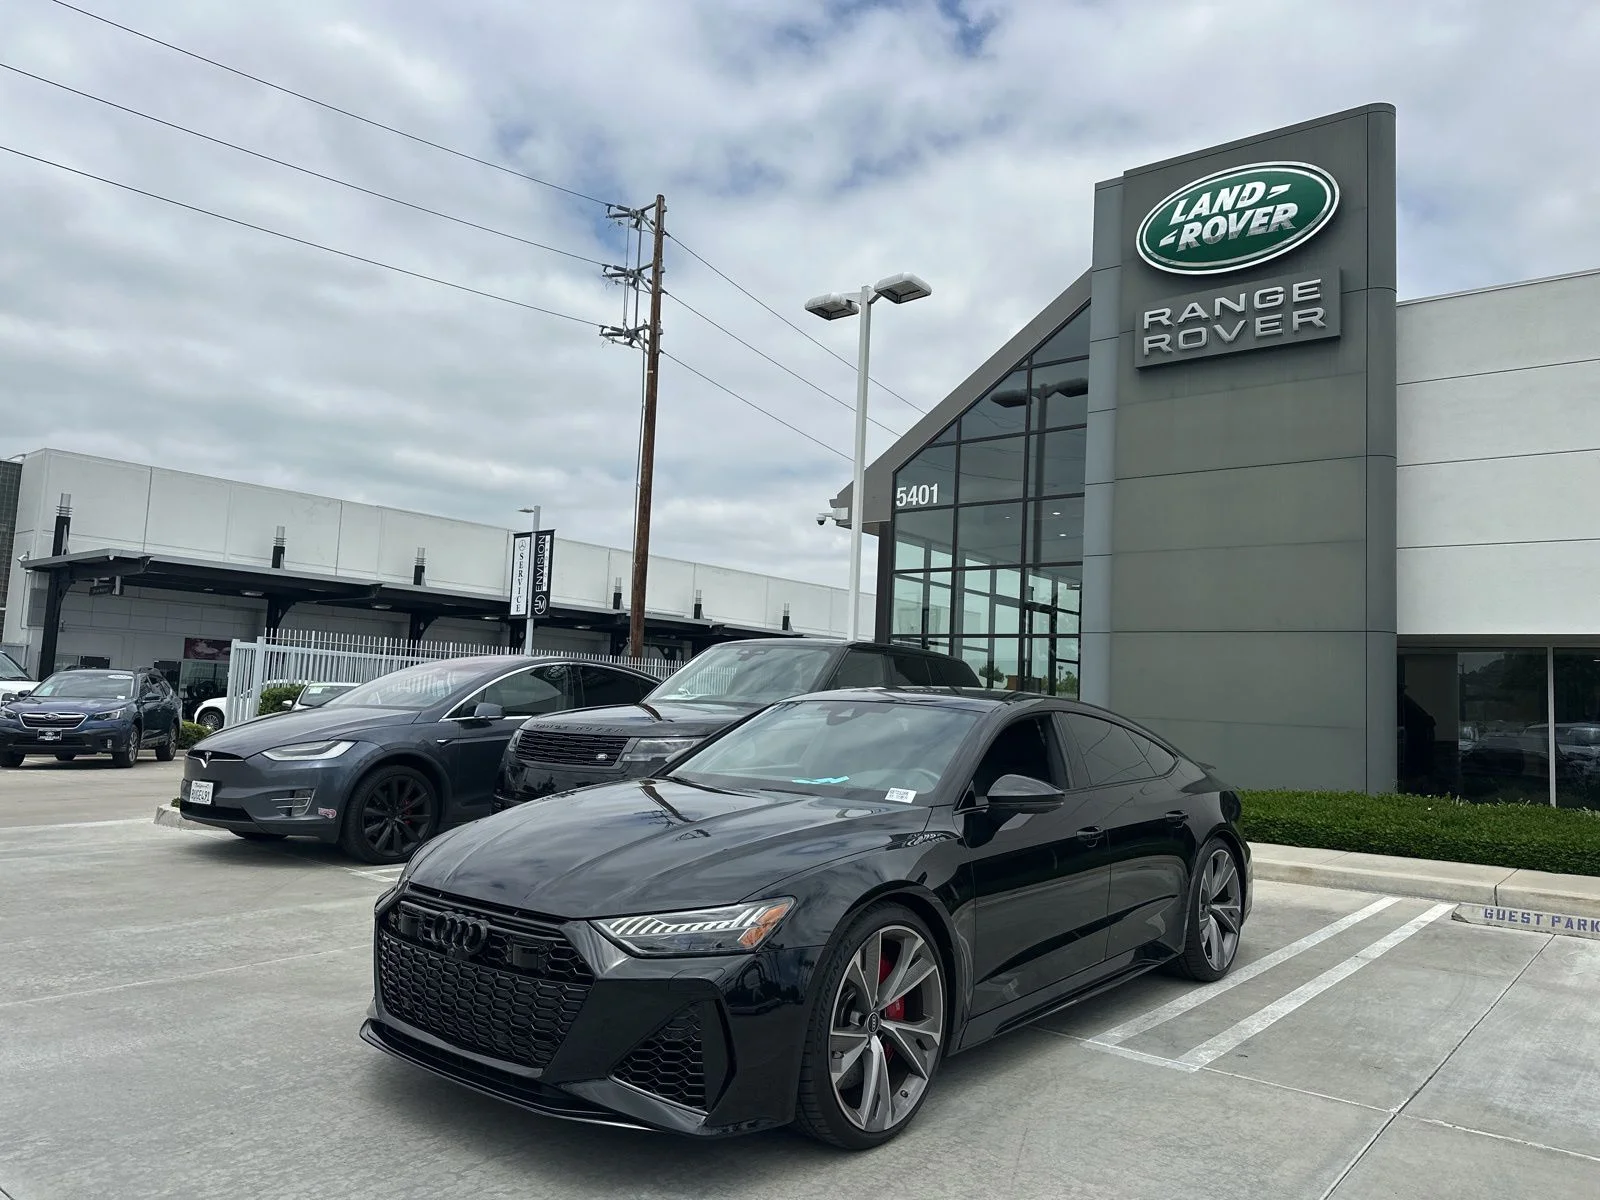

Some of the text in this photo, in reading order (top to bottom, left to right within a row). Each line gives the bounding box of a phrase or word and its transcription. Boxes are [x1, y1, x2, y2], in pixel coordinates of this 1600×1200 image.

[1169, 181, 1266, 226] LAND
[1176, 202, 1299, 252] ROVER
[1143, 278, 1322, 330] RANGE
[1143, 306, 1327, 356] ROVER
[896, 483, 939, 507] 5401
[516, 552, 524, 613] SERVICE
[536, 535, 546, 592] ENVISION
[1484, 908, 1600, 933] GUEST PARK
